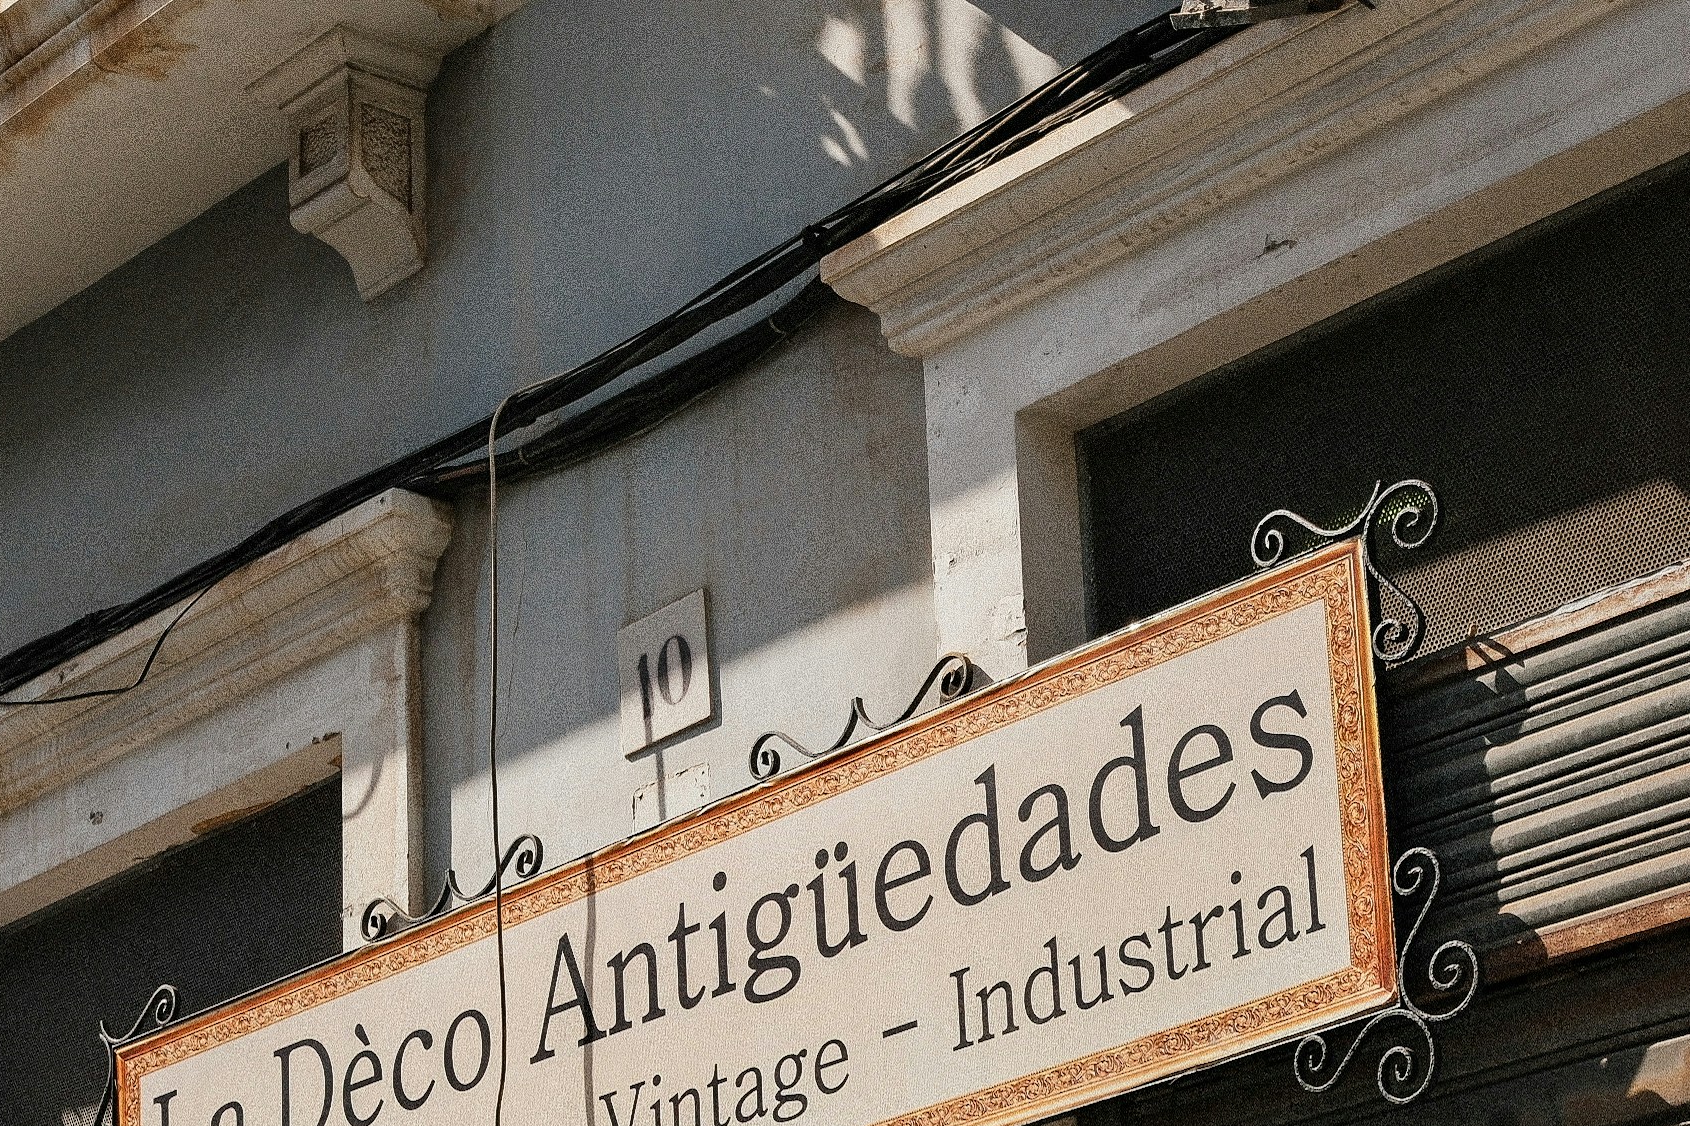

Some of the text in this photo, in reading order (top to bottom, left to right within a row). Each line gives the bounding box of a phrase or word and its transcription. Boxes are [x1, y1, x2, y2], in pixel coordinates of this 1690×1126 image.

[638, 634, 692, 723] 10
[530, 688, 1314, 1064] Antigüedades
[950, 846, 1326, 1051] Industrial
